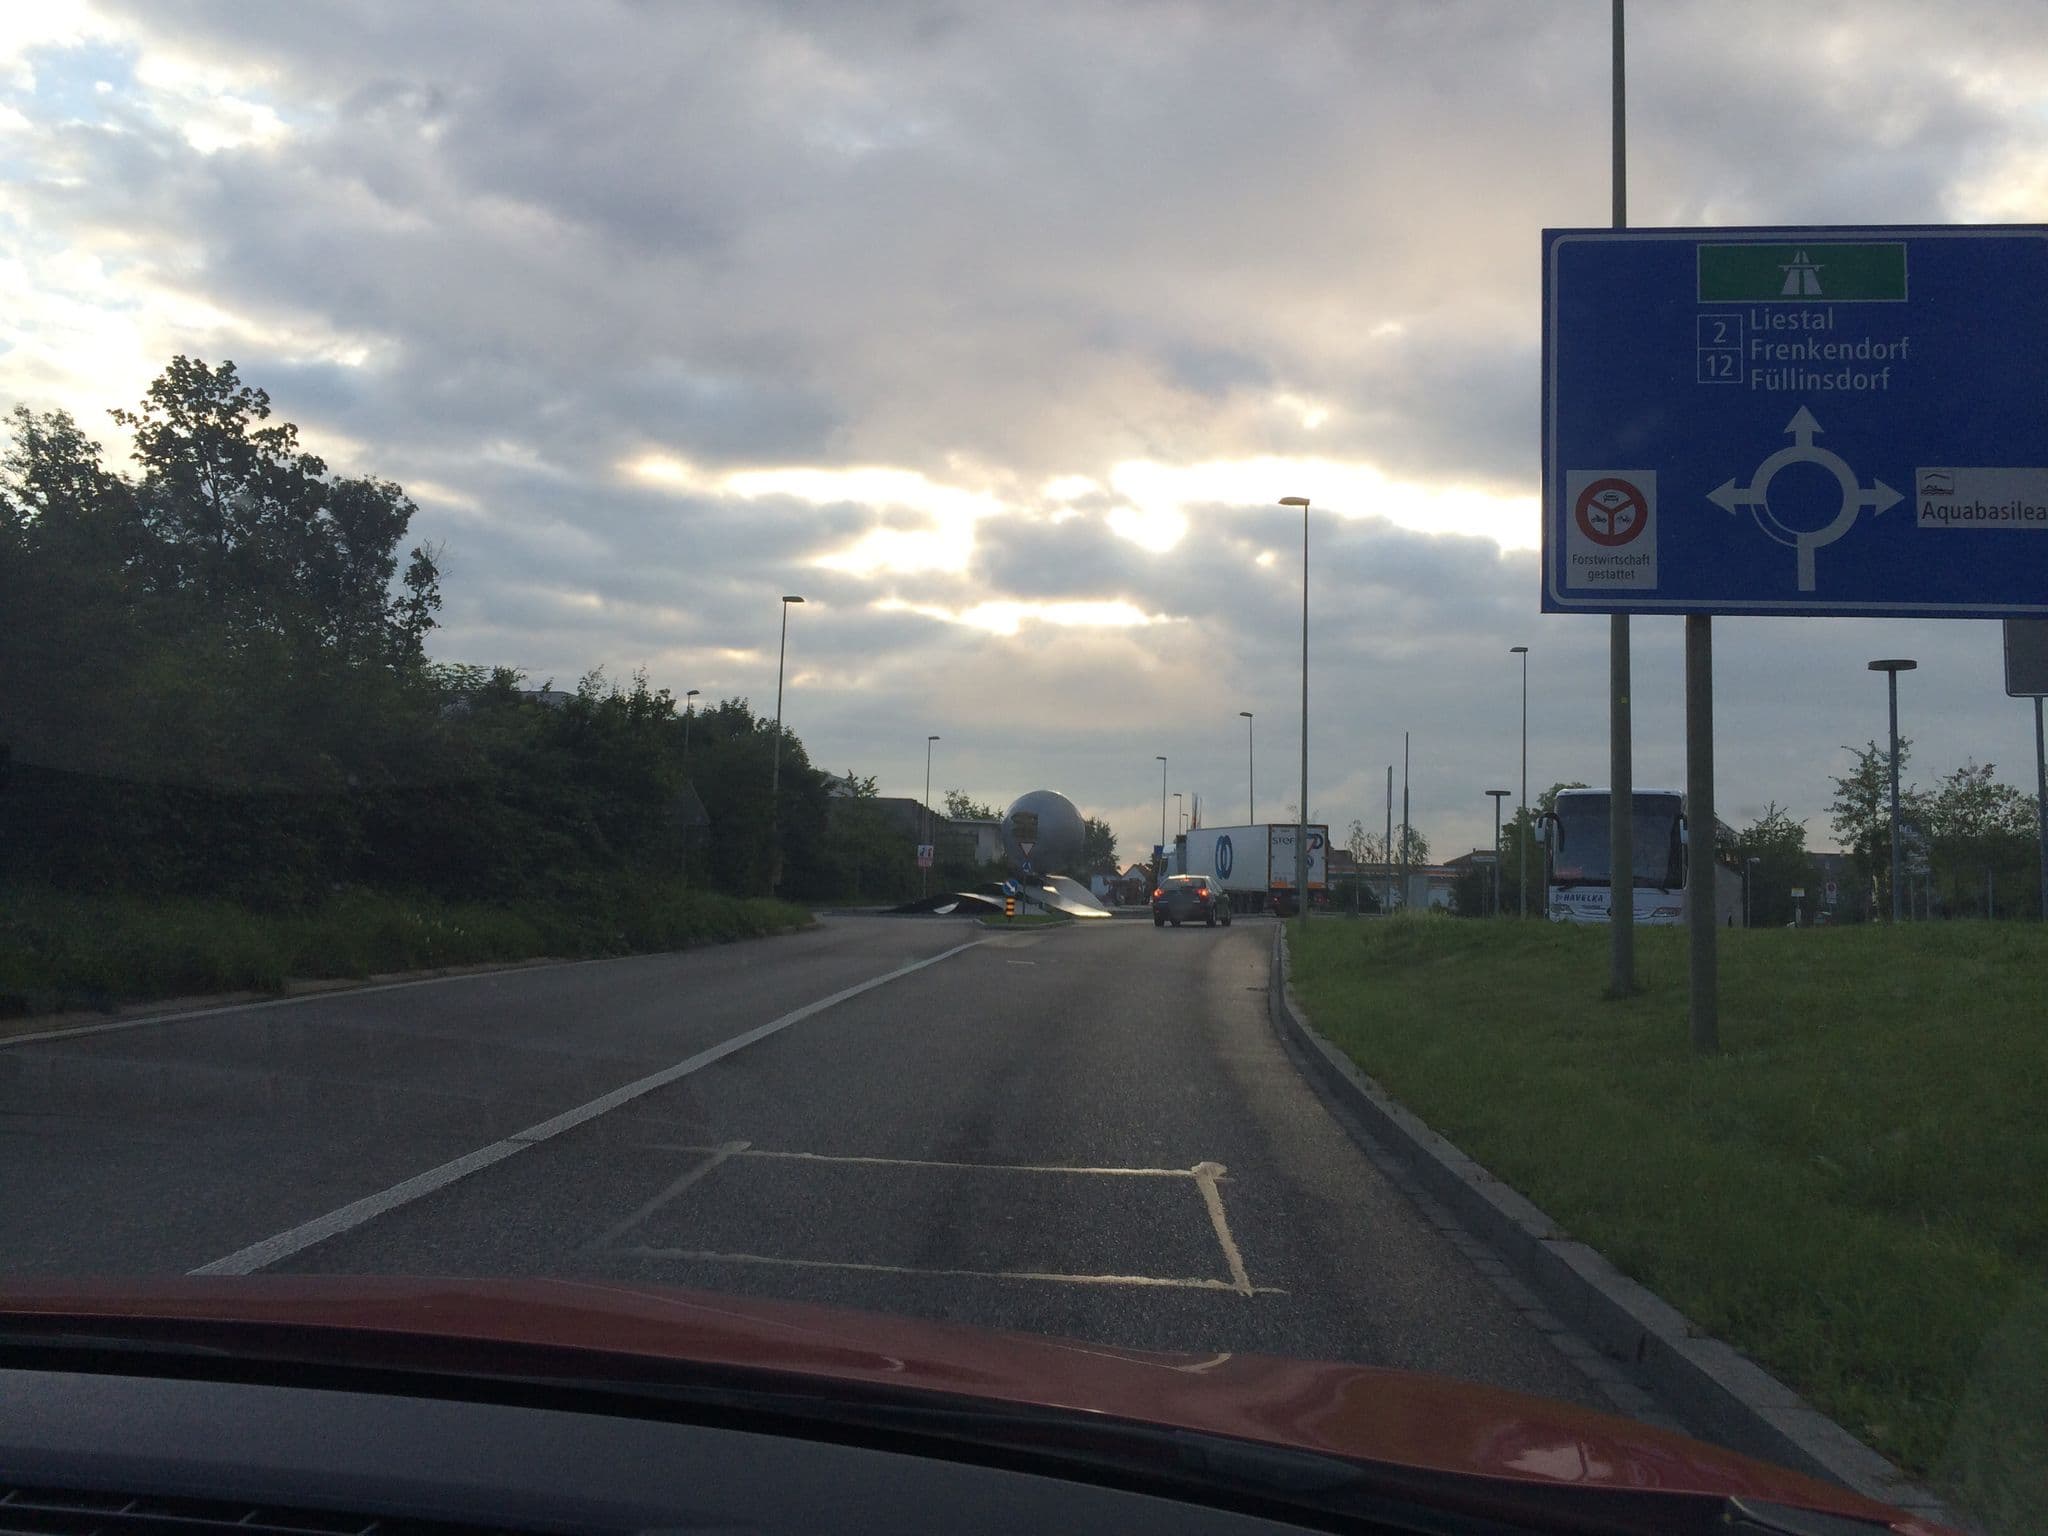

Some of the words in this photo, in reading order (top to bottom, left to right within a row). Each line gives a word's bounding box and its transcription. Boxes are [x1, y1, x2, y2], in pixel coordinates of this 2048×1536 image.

[1751, 307, 1834, 330] Liestal
[1713, 321, 1727, 343] 2
[1751, 336, 1910, 360] Frenkendorf
[1706, 355, 1733, 377] 12
[1751, 367, 1890, 390] Füllinsdorf
[1920, 499, 2048, 525] Aquabasilea
[1572, 553, 1650, 566] Forstwirtschaft
[1587, 569, 1636, 582] gestattet
